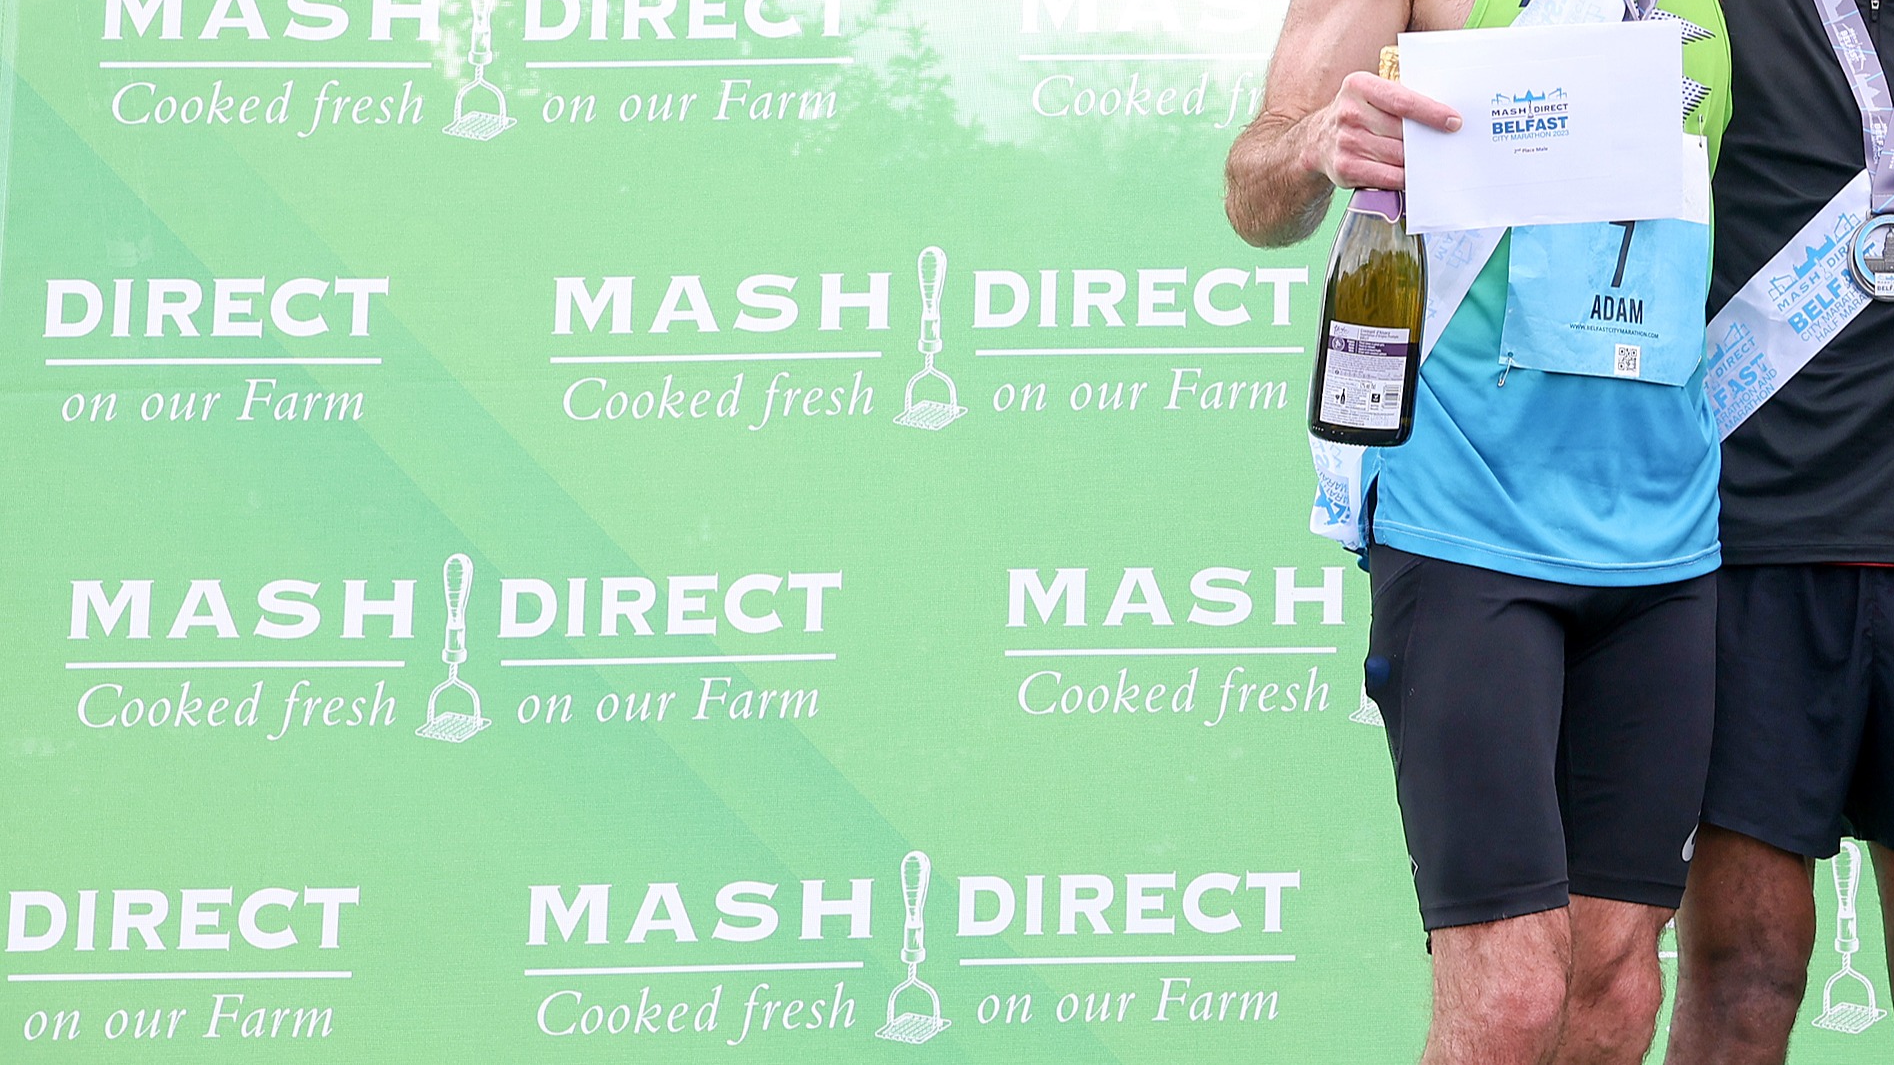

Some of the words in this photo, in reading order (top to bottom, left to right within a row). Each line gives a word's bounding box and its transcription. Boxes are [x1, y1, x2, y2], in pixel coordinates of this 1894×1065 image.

[112, 80, 294, 124] Cooked
[297, 79, 423, 138] fresh
[542, 92, 595, 123] on
[619, 94, 697, 122] our
[714, 75, 842, 120] Farm
[1032, 73, 1208, 116] Cooked
[1492, 107, 1526, 117] MASH
[1534, 103, 1568, 113] DIRECT
[1492, 116, 1568, 135] BELFAST
[1511, 132, 1551, 141] MARATHON
[1609, 220, 1636, 288] 7
[44, 276, 390, 337] DIRECT
[553, 272, 891, 334] MASH
[973, 267, 1308, 328] DIRECT
[1590, 294, 1643, 325] ADAM
[1777, 272, 1821, 312] MASH
[1715, 337, 1757, 378] DIRECT
[1800, 320, 1822, 342] CITY
[1816, 322, 1838, 343] HALF
[61, 393, 117, 422] on
[141, 393, 221, 421] our
[237, 378, 364, 420] Farm
[563, 373, 744, 420] Cooked
[748, 370, 873, 431] fresh
[993, 383, 1046, 411] on
[1070, 382, 1147, 411] our
[1165, 368, 1287, 409] Farm
[1758, 368, 1777, 389] AND
[68, 579, 416, 639] MASH
[499, 571, 843, 638] DIRECT
[1007, 567, 1344, 627] MASH
[77, 681, 263, 728] Cooked
[267, 680, 396, 741] fresh
[517, 694, 572, 724] on
[596, 692, 676, 722] our
[693, 677, 819, 720] Farm
[1018, 667, 1198, 715] Cooked
[1204, 666, 1329, 727] fresh
[6, 887, 360, 952] DIRECT
[527, 878, 873, 945] MASH
[958, 871, 1300, 936] DIRECT
[24, 1010, 80, 1040] on
[105, 1009, 186, 1039] our
[204, 994, 332, 1038] Farm
[537, 985, 722, 1036] Cooked
[727, 982, 855, 1046] fresh
[977, 994, 1031, 1024] on
[1056, 993, 1136, 1022] our
[1153, 977, 1278, 1021] Farm
